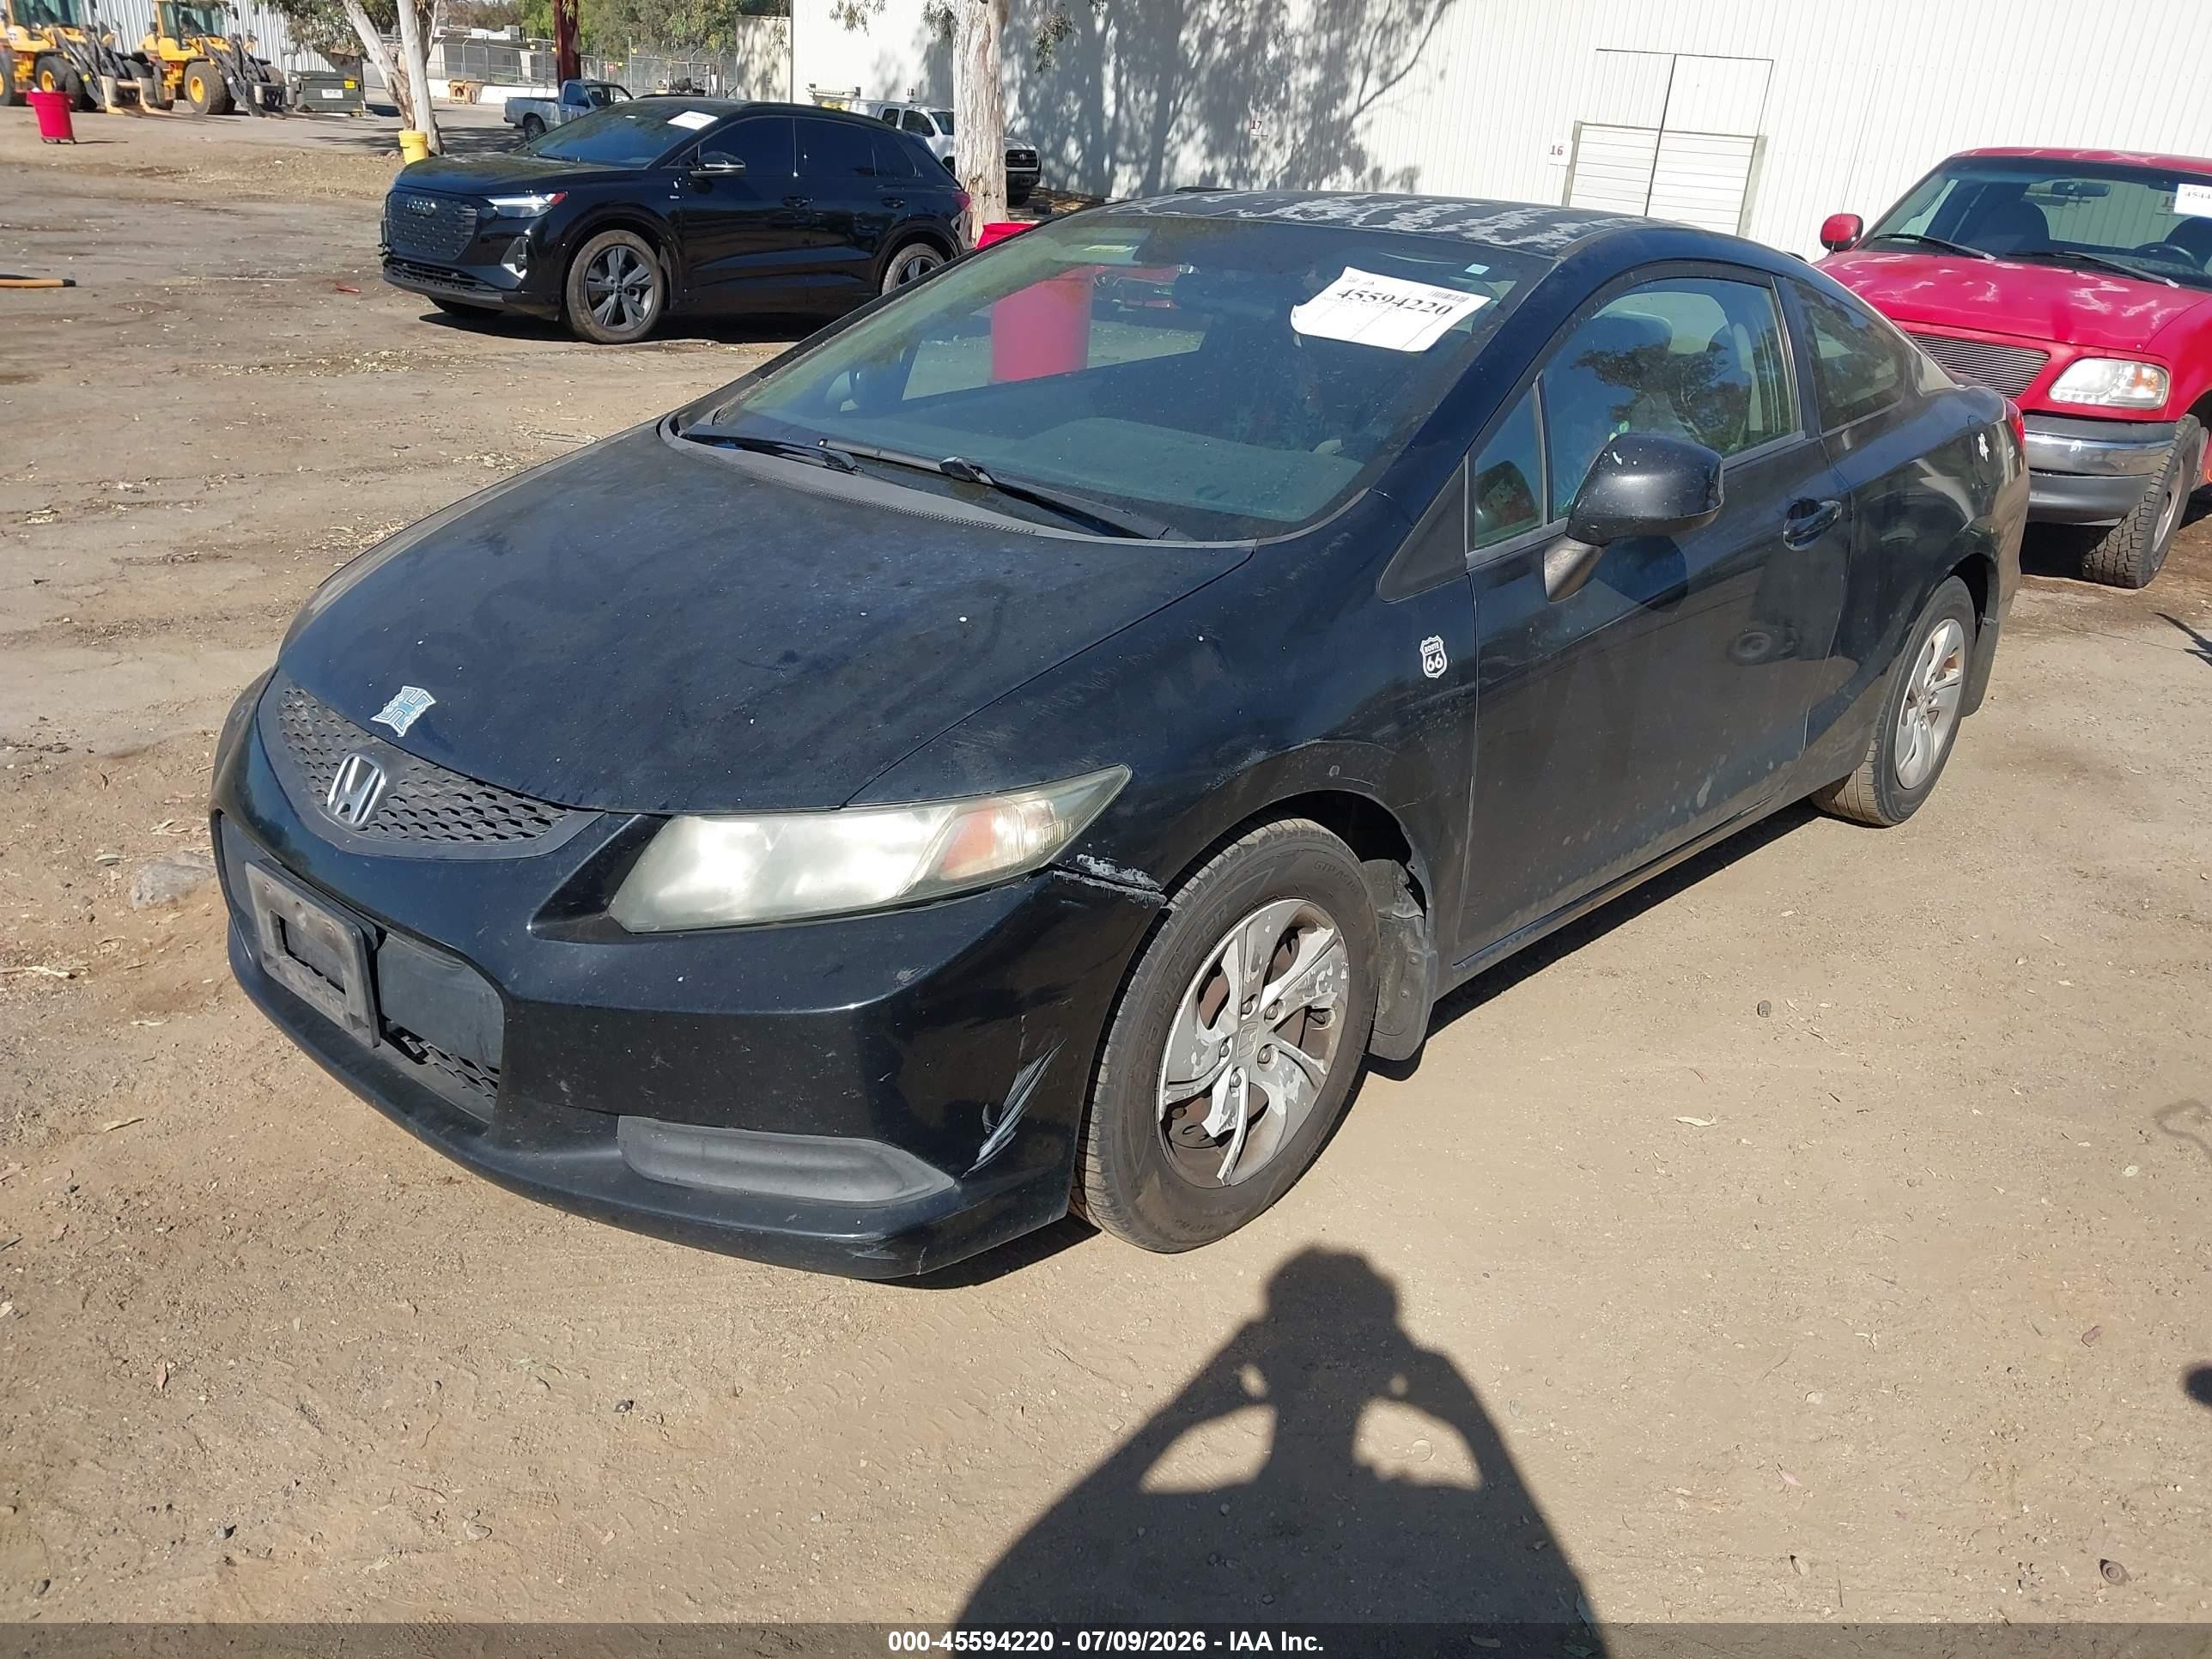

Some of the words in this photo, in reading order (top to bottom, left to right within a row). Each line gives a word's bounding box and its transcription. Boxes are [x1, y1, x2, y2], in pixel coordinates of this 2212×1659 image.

[1250, 119, 1262, 130] 17
[1549, 144, 1564, 155] 16
[1336, 288, 1453, 316] 45594220
[1426, 653, 1443, 672] 66
